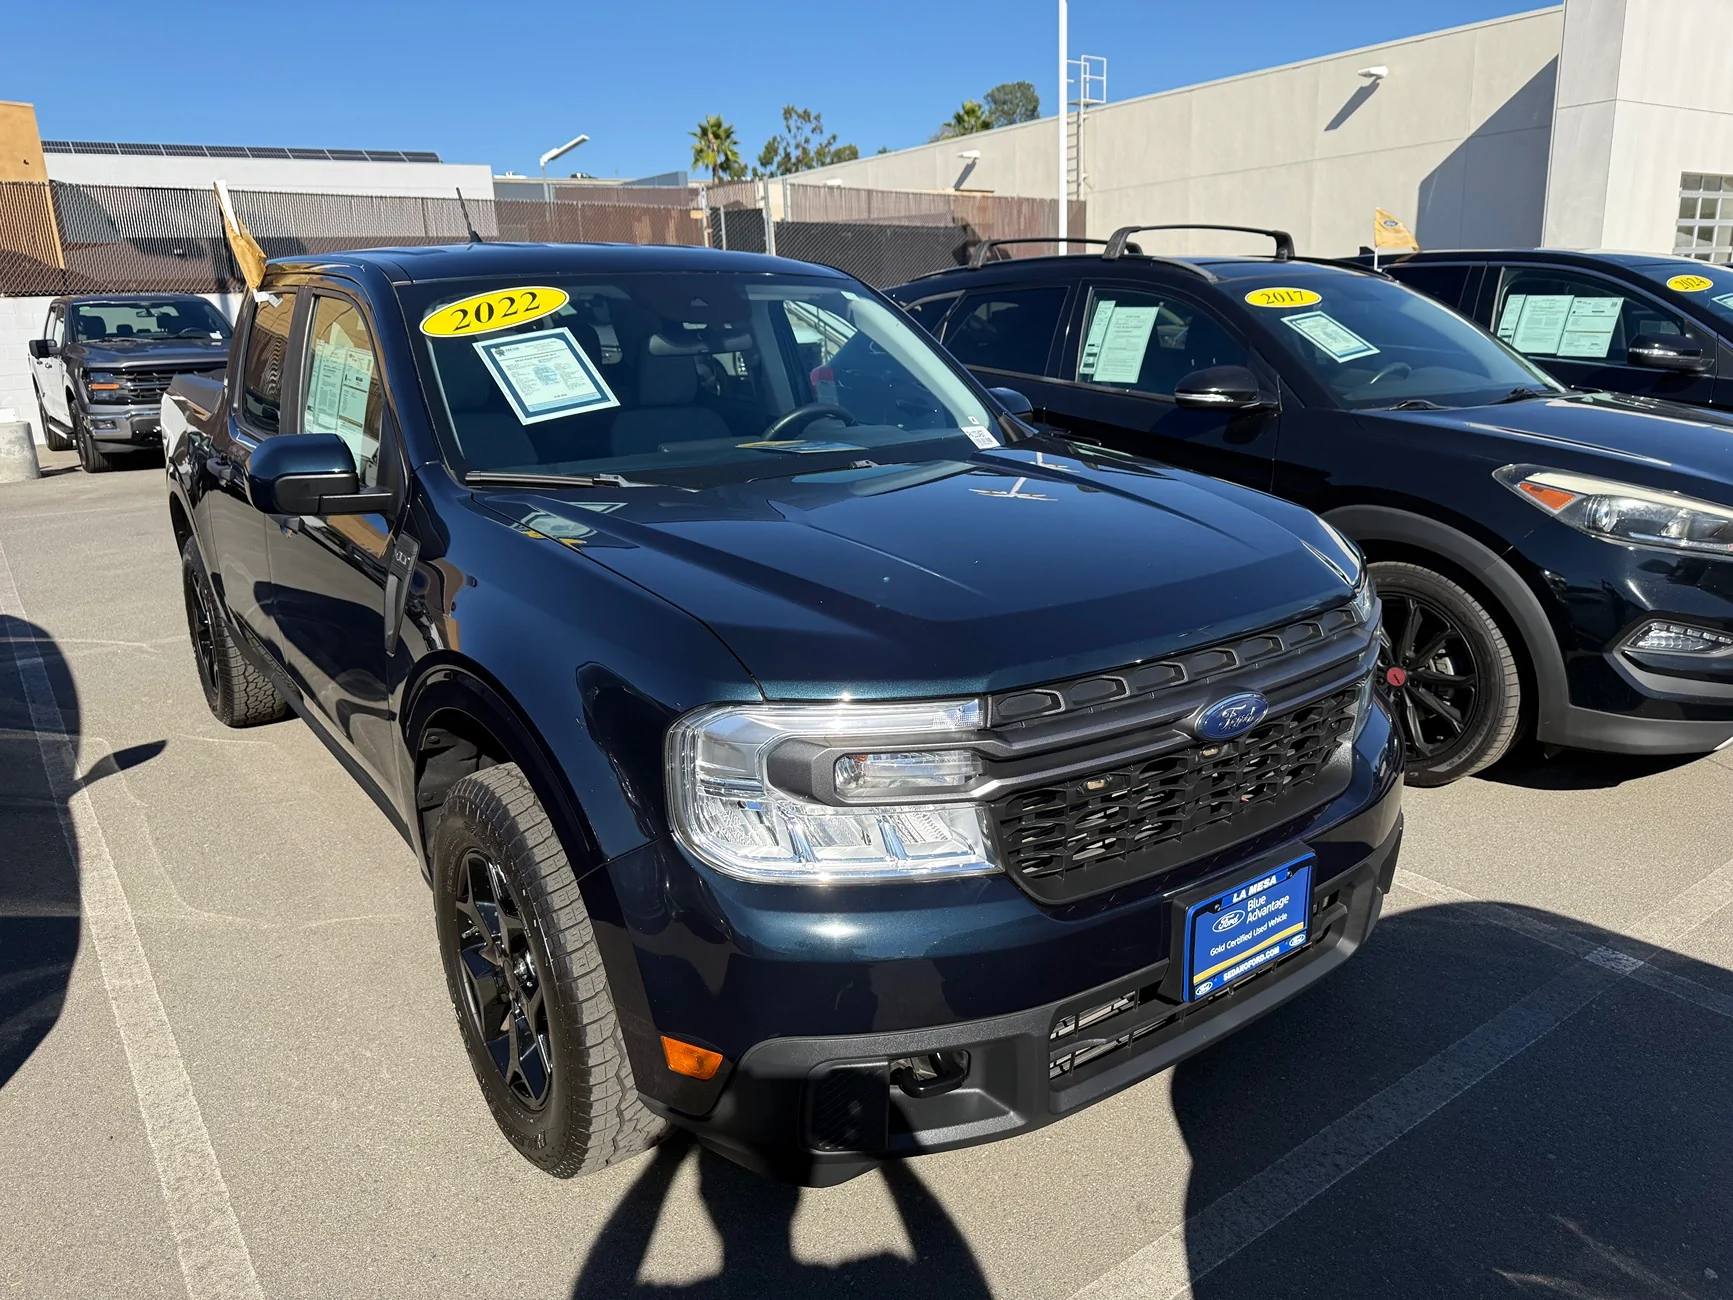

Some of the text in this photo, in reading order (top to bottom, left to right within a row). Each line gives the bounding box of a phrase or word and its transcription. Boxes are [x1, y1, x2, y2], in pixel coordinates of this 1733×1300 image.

[1674, 276, 1707, 290] 2024
[450, 291, 541, 332] 2022
[1260, 290, 1304, 305] 2017
[1218, 703, 1257, 733] Ford
[1232, 875, 1277, 903] LA MESA
[1246, 895, 1290, 924] Advantage
[1247, 895, 1267, 912] Blue
[1210, 912, 1288, 957] Gold Certified Used Vehicle
[1217, 913, 1240, 930] Ford
[1223, 945, 1280, 981] SEDANOFORD.COM
